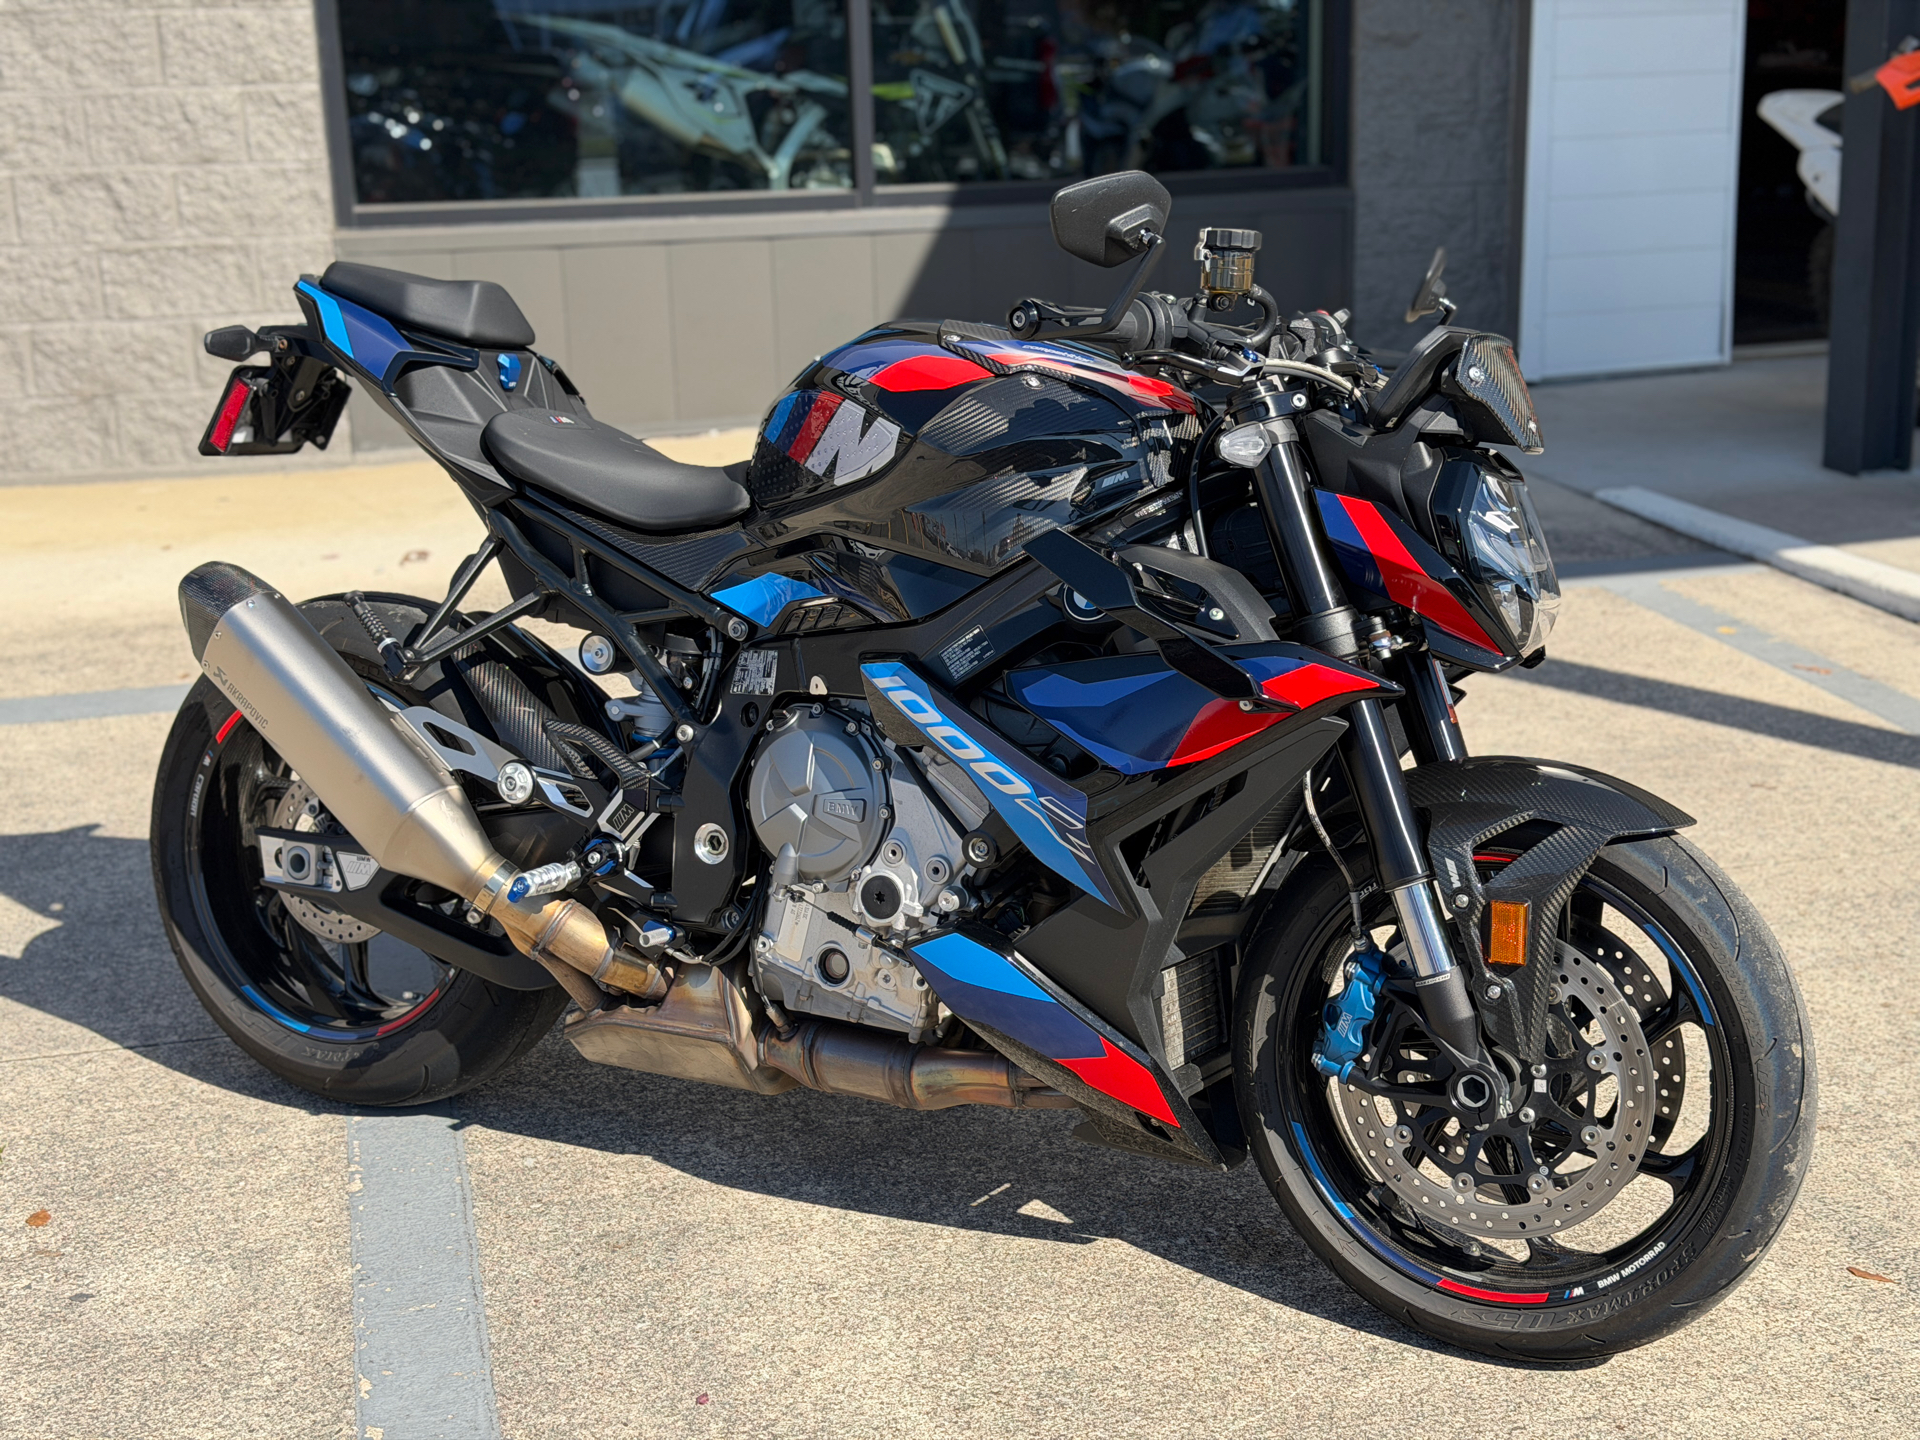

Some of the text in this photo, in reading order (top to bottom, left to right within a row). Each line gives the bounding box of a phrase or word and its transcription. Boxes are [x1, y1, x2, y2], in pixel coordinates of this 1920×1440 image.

[226, 682, 269, 729] AKRAPOVIC
[872, 675, 1032, 795] 1000
[827, 801, 858, 816] BMW
[1597, 1241, 1666, 1289] BMW MOTORRAD
